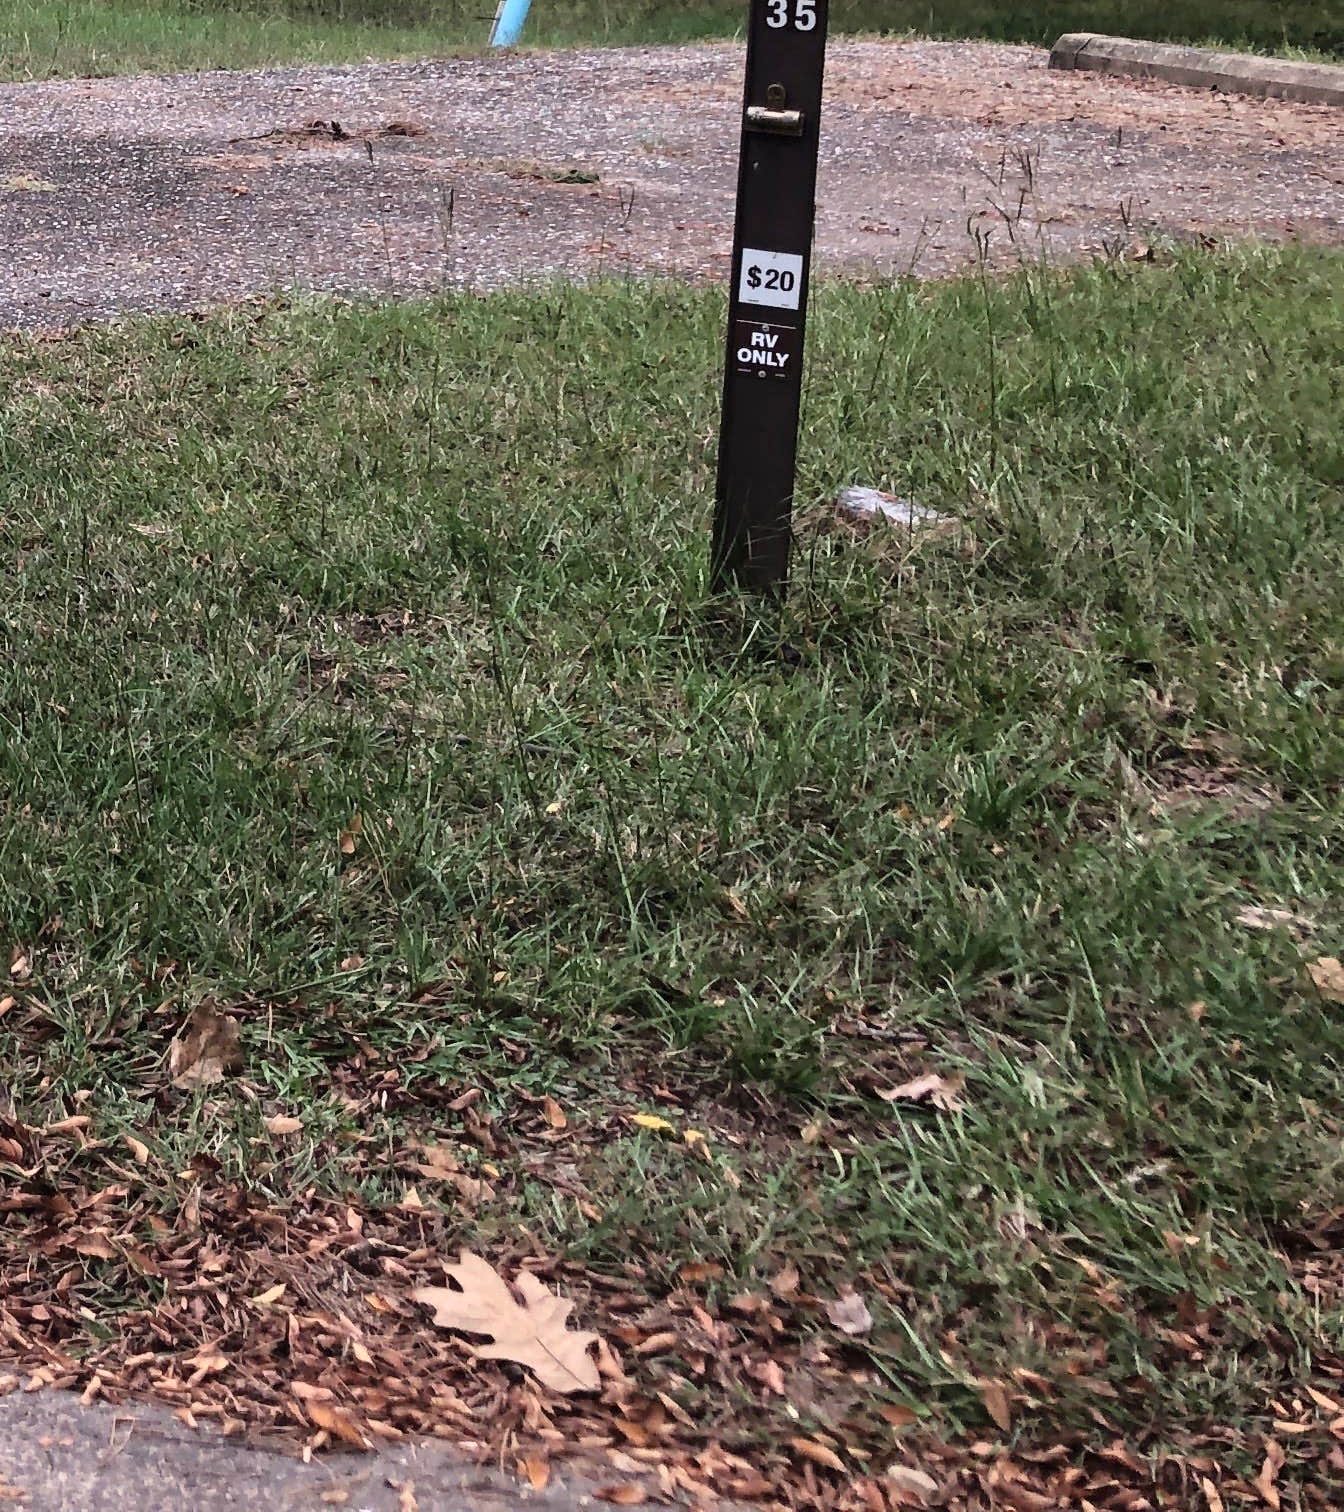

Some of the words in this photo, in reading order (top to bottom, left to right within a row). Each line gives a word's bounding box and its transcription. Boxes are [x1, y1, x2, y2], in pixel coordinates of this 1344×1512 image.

[746, 264, 795, 292] $20
[750, 331, 779, 348] RV
[736, 347, 790, 368] ONLY
